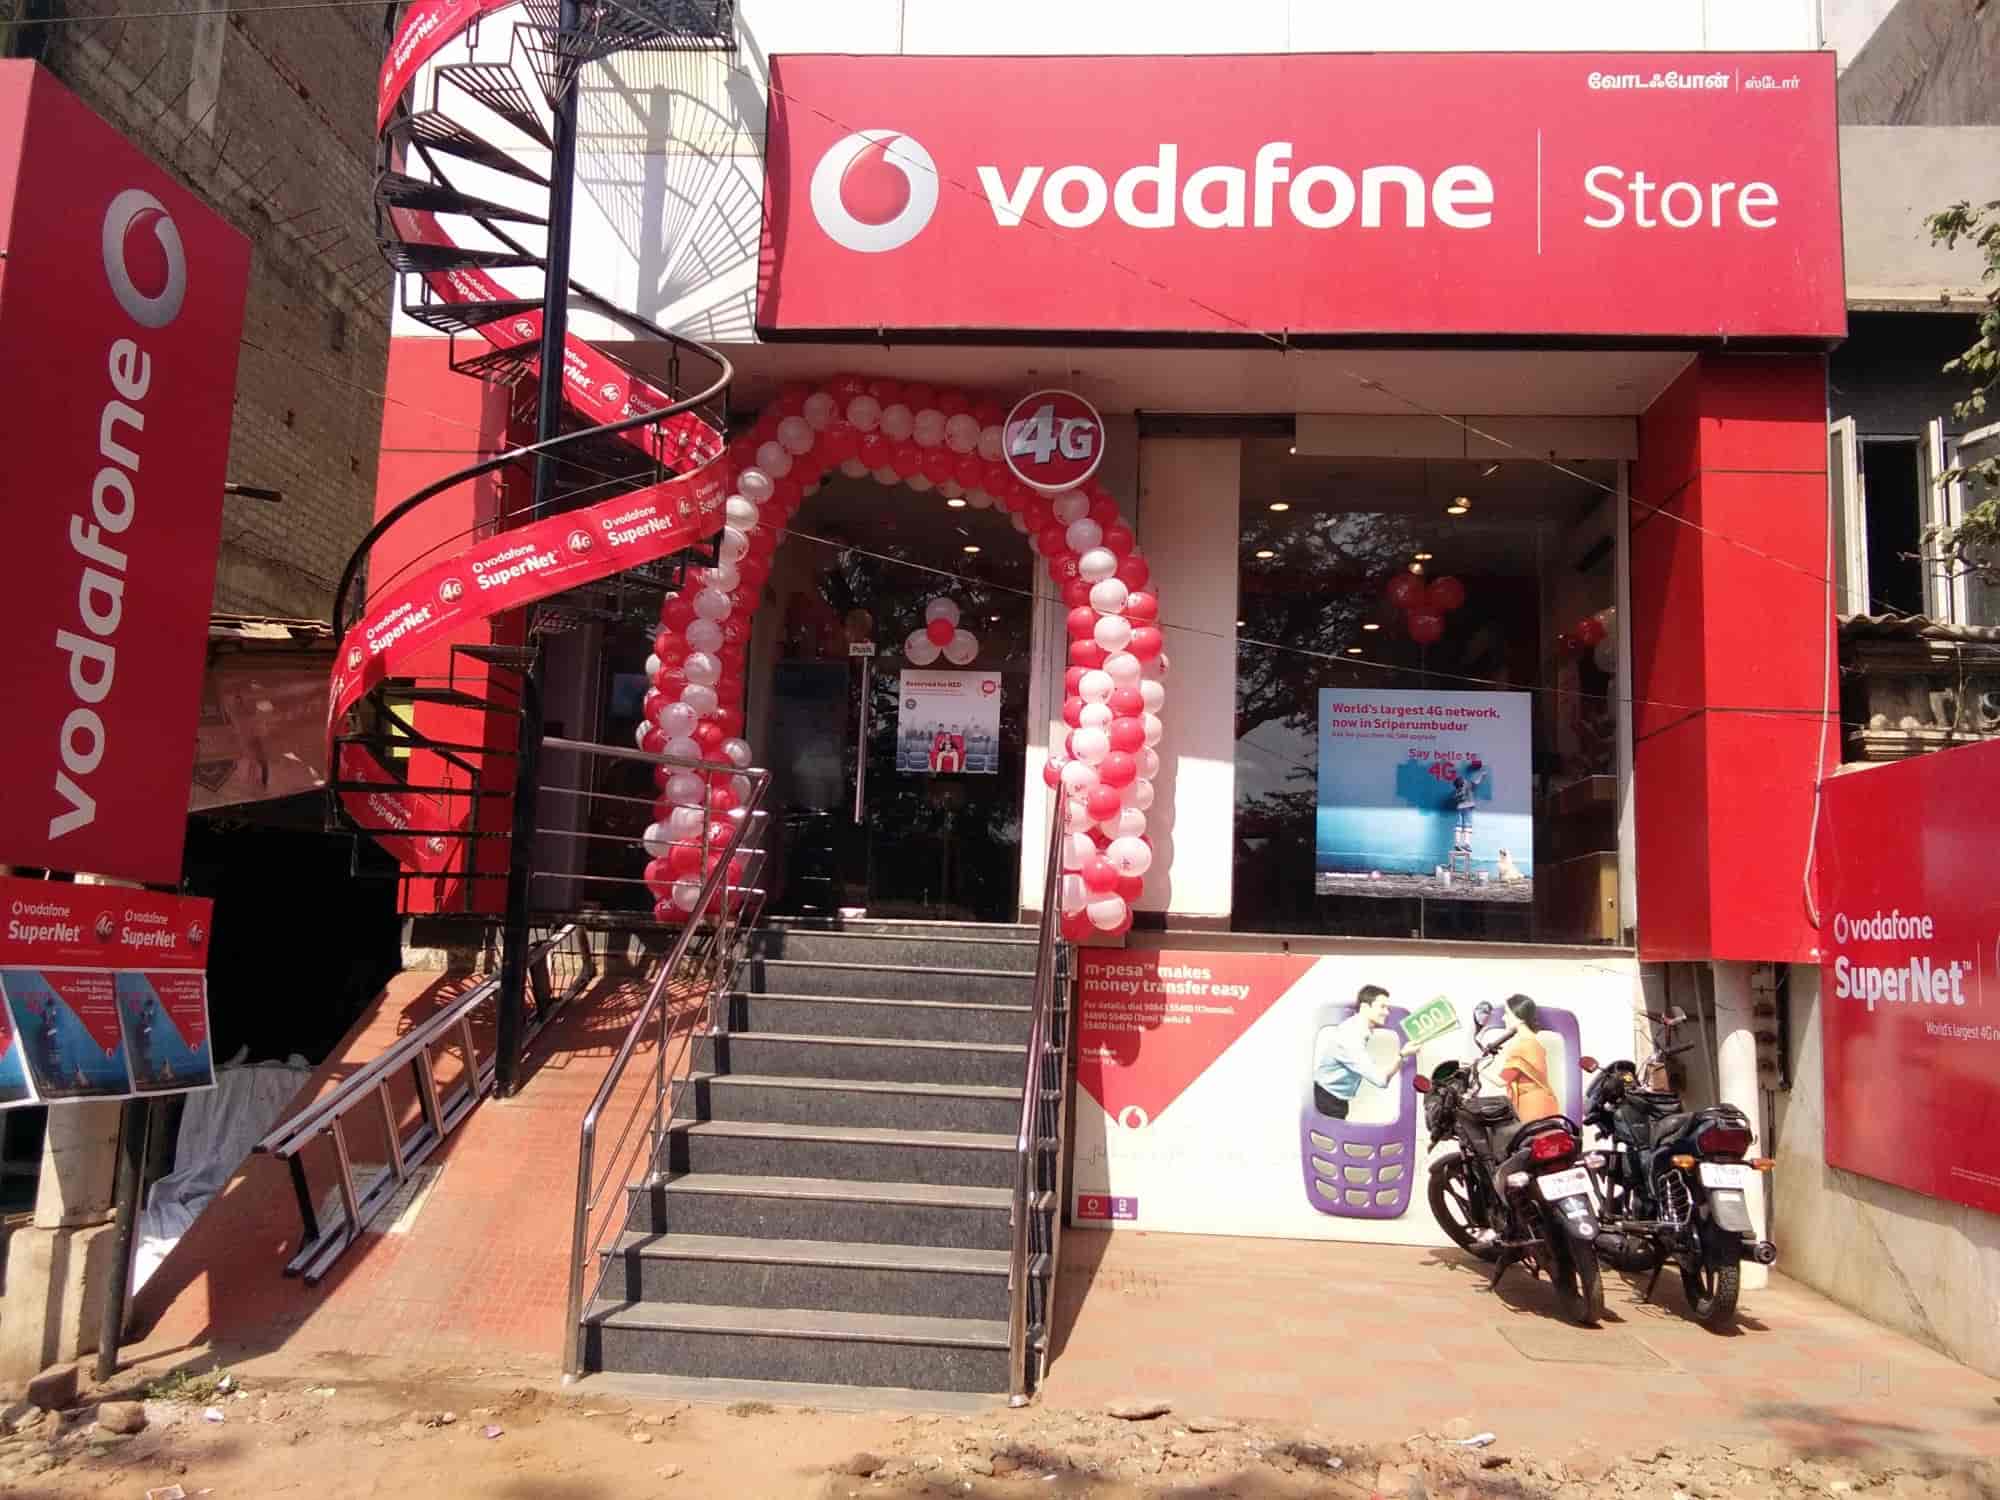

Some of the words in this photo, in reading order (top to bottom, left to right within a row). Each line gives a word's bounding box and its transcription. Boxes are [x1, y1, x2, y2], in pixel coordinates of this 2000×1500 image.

[1587, 70, 1731, 89] வோடஃபோன்
[976, 141, 1495, 229] vodafone
[1583, 165, 1779, 229] Store
[514, 320, 534, 338] 4G
[601, 386, 619, 401] 4G
[1012, 404, 1093, 464] 4G
[611, 505, 657, 527] vodafone
[607, 514, 673, 547] SuperNet
[570, 533, 592, 551] 4G
[483, 543, 536, 567] vodafone
[476, 551, 557, 590] SuperNet
[48, 338, 151, 841] vodafone
[442, 582, 462, 600] 4G
[374, 602, 412, 633] vodafone
[369, 606, 432, 655] SuperNet
[1332, 703, 1377, 714] World's
[1380, 704, 1425, 717] largest
[1426, 706, 1443, 716] 4G
[1332, 718, 1357, 729] now
[1359, 718, 1372, 729] in
[1408, 748, 1430, 761] Say
[1434, 750, 1463, 761] hello
[1427, 761, 1457, 782] 4G
[24, 902, 71, 918] vodafone
[134, 910, 168, 925] vodafone
[8, 919, 81, 944] SuperNet
[96, 915, 114, 936] 4G
[1850, 909, 1934, 941] vodafone
[121, 926, 178, 949] SuperNet
[1158, 965, 1211, 979] makes
[1084, 979, 1139, 995] money
[1143, 980, 1209, 994] transfer
[1211, 985, 1250, 1001] easy
[1410, 1007, 1443, 1034] 100
